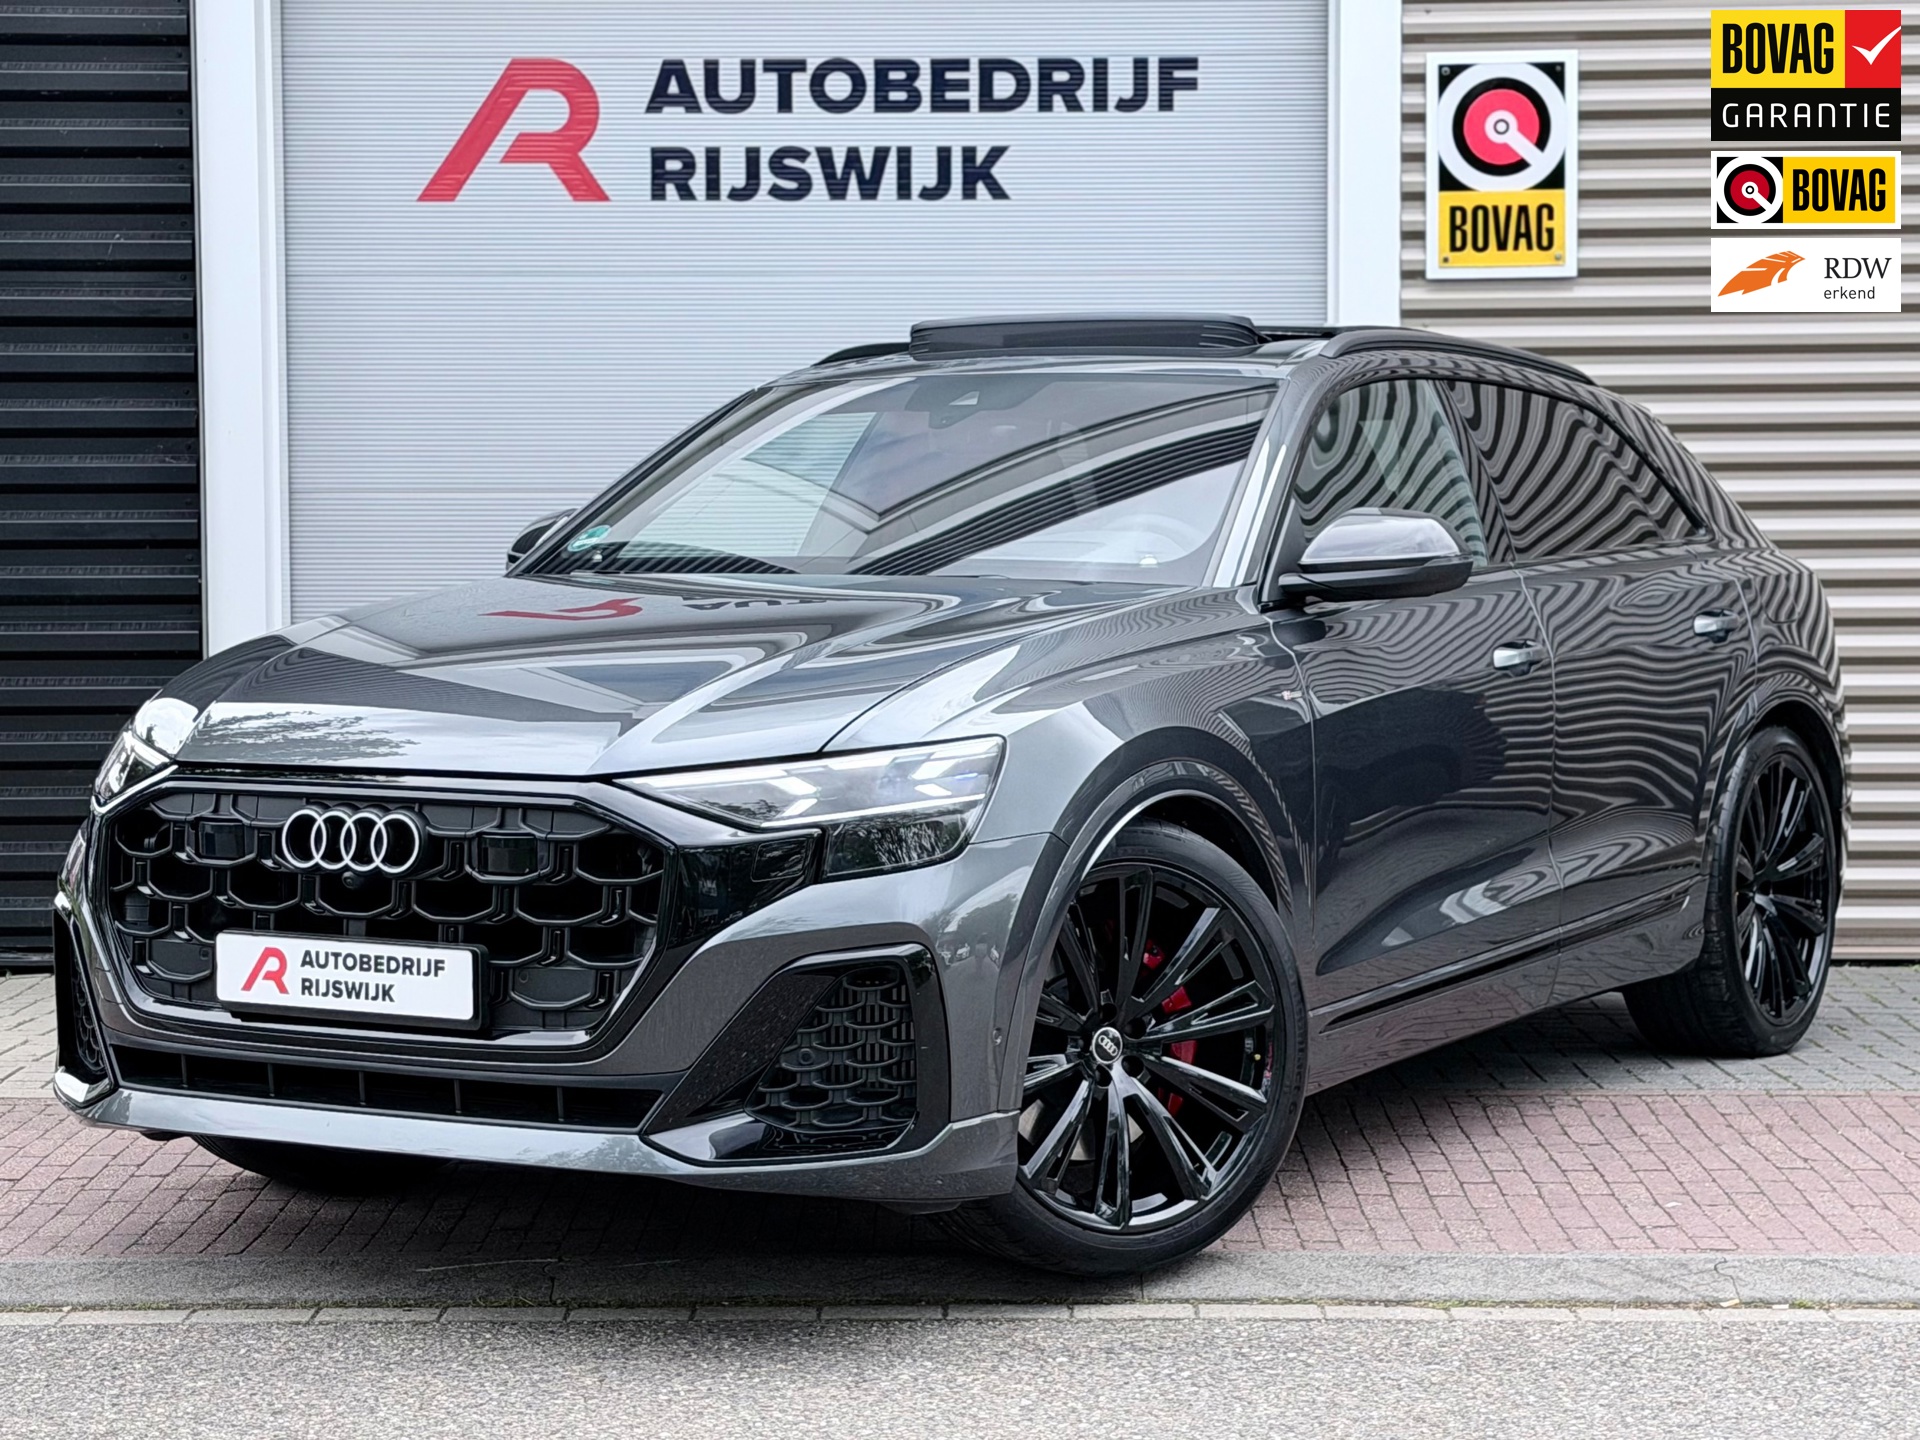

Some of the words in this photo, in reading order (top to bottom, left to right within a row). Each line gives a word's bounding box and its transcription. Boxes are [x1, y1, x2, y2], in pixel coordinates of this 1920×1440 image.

[645, 57, 1199, 114] AUTOBEDRIJF
[651, 146, 1011, 202] RIJSWIJK
[1448, 203, 1554, 253] BOVAG
[300, 949, 446, 977] AUTOBEDRIJF
[300, 978, 396, 1003] RIJSWIJK
